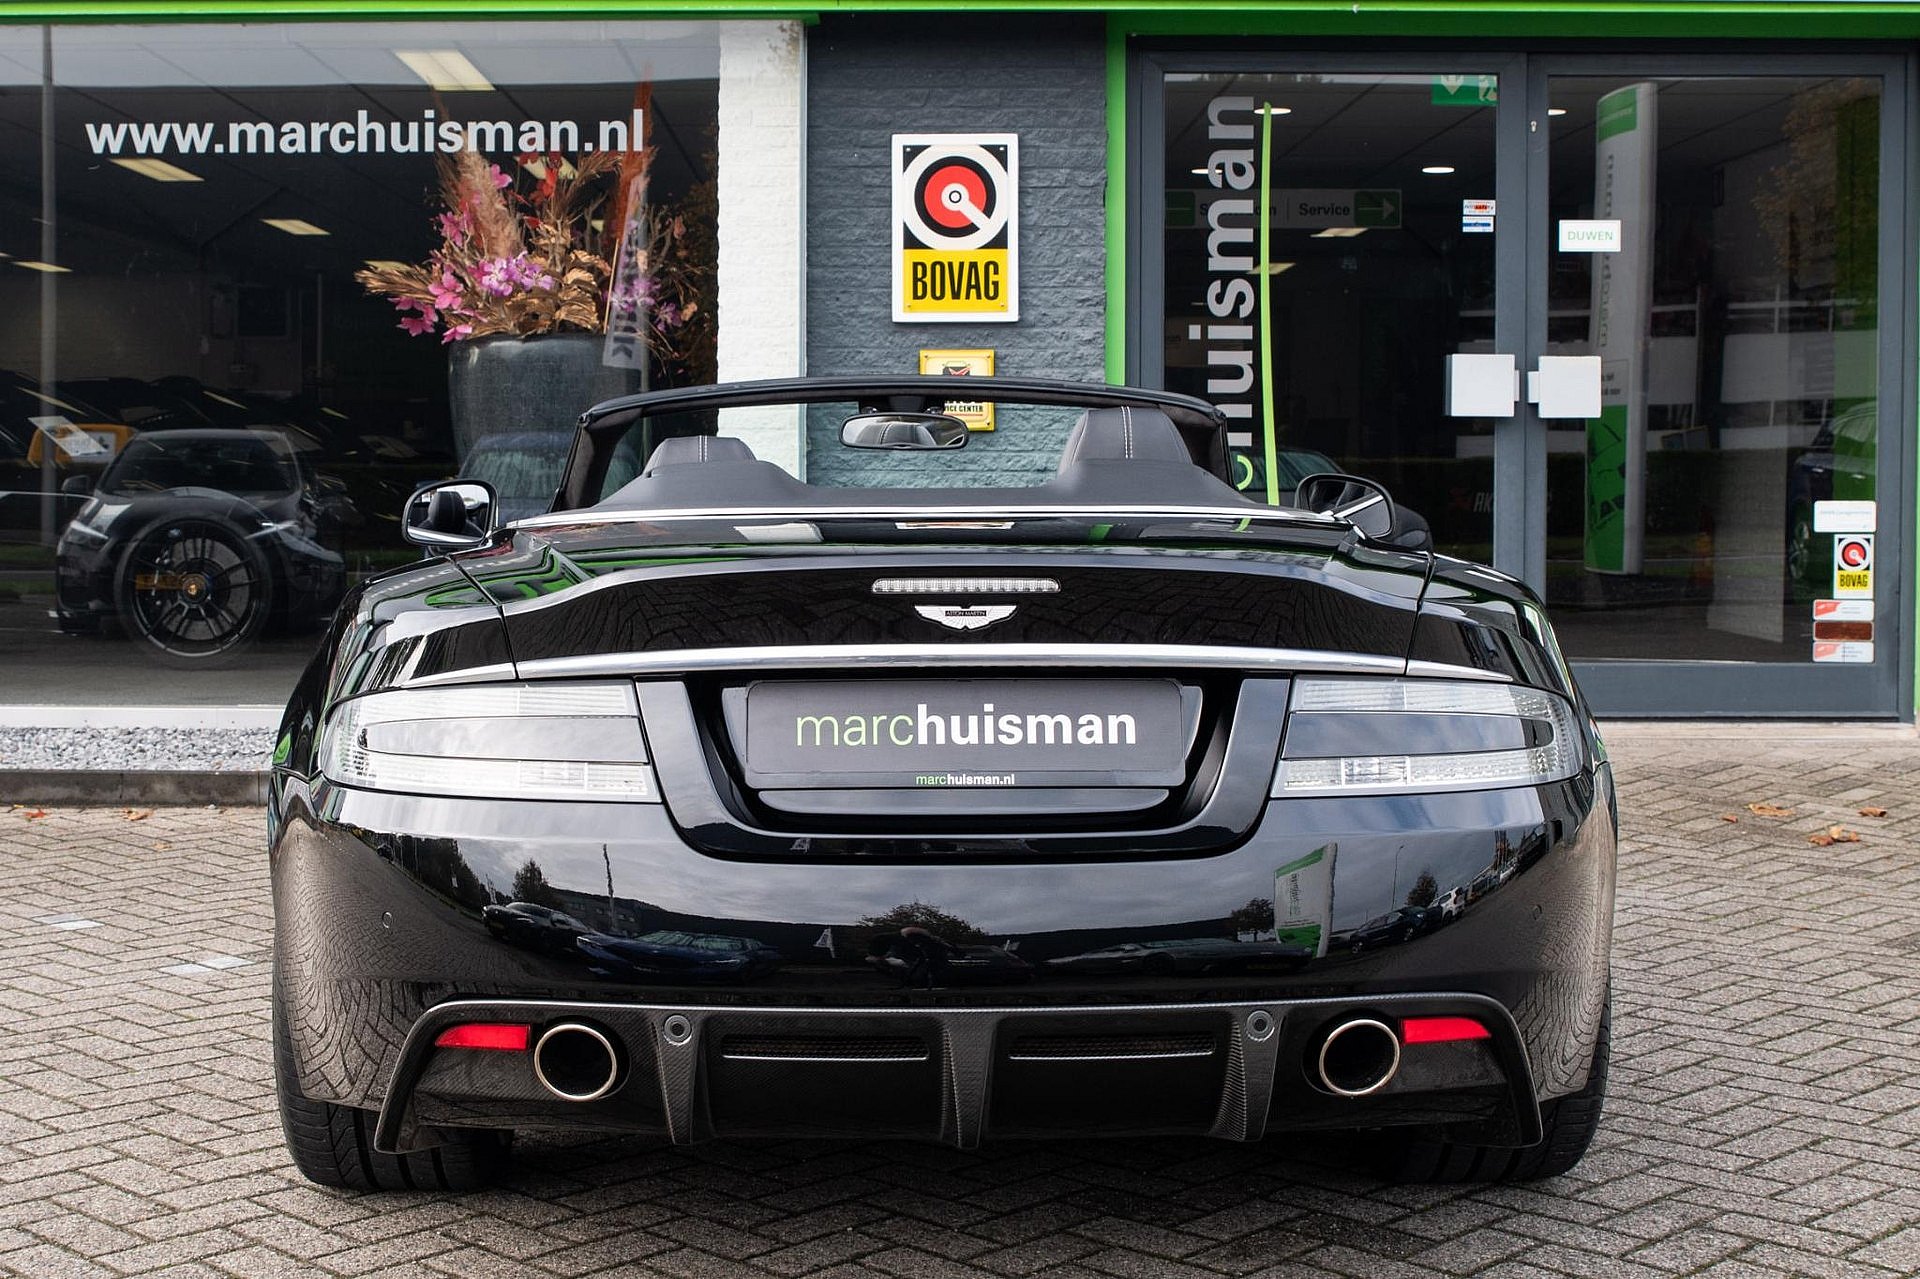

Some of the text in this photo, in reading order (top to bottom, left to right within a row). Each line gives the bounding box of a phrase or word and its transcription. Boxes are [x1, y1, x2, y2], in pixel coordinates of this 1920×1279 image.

[85, 108, 643, 154] www.marchuisman.nl
[1298, 204, 1350, 216] Service
[1567, 231, 1613, 241] DUWEN
[912, 260, 999, 301] BOVAG
[1839, 574, 1868, 588] BOVAG
[796, 703, 1137, 746] marchuisman
[915, 773, 1016, 786] marchuisman.nl
